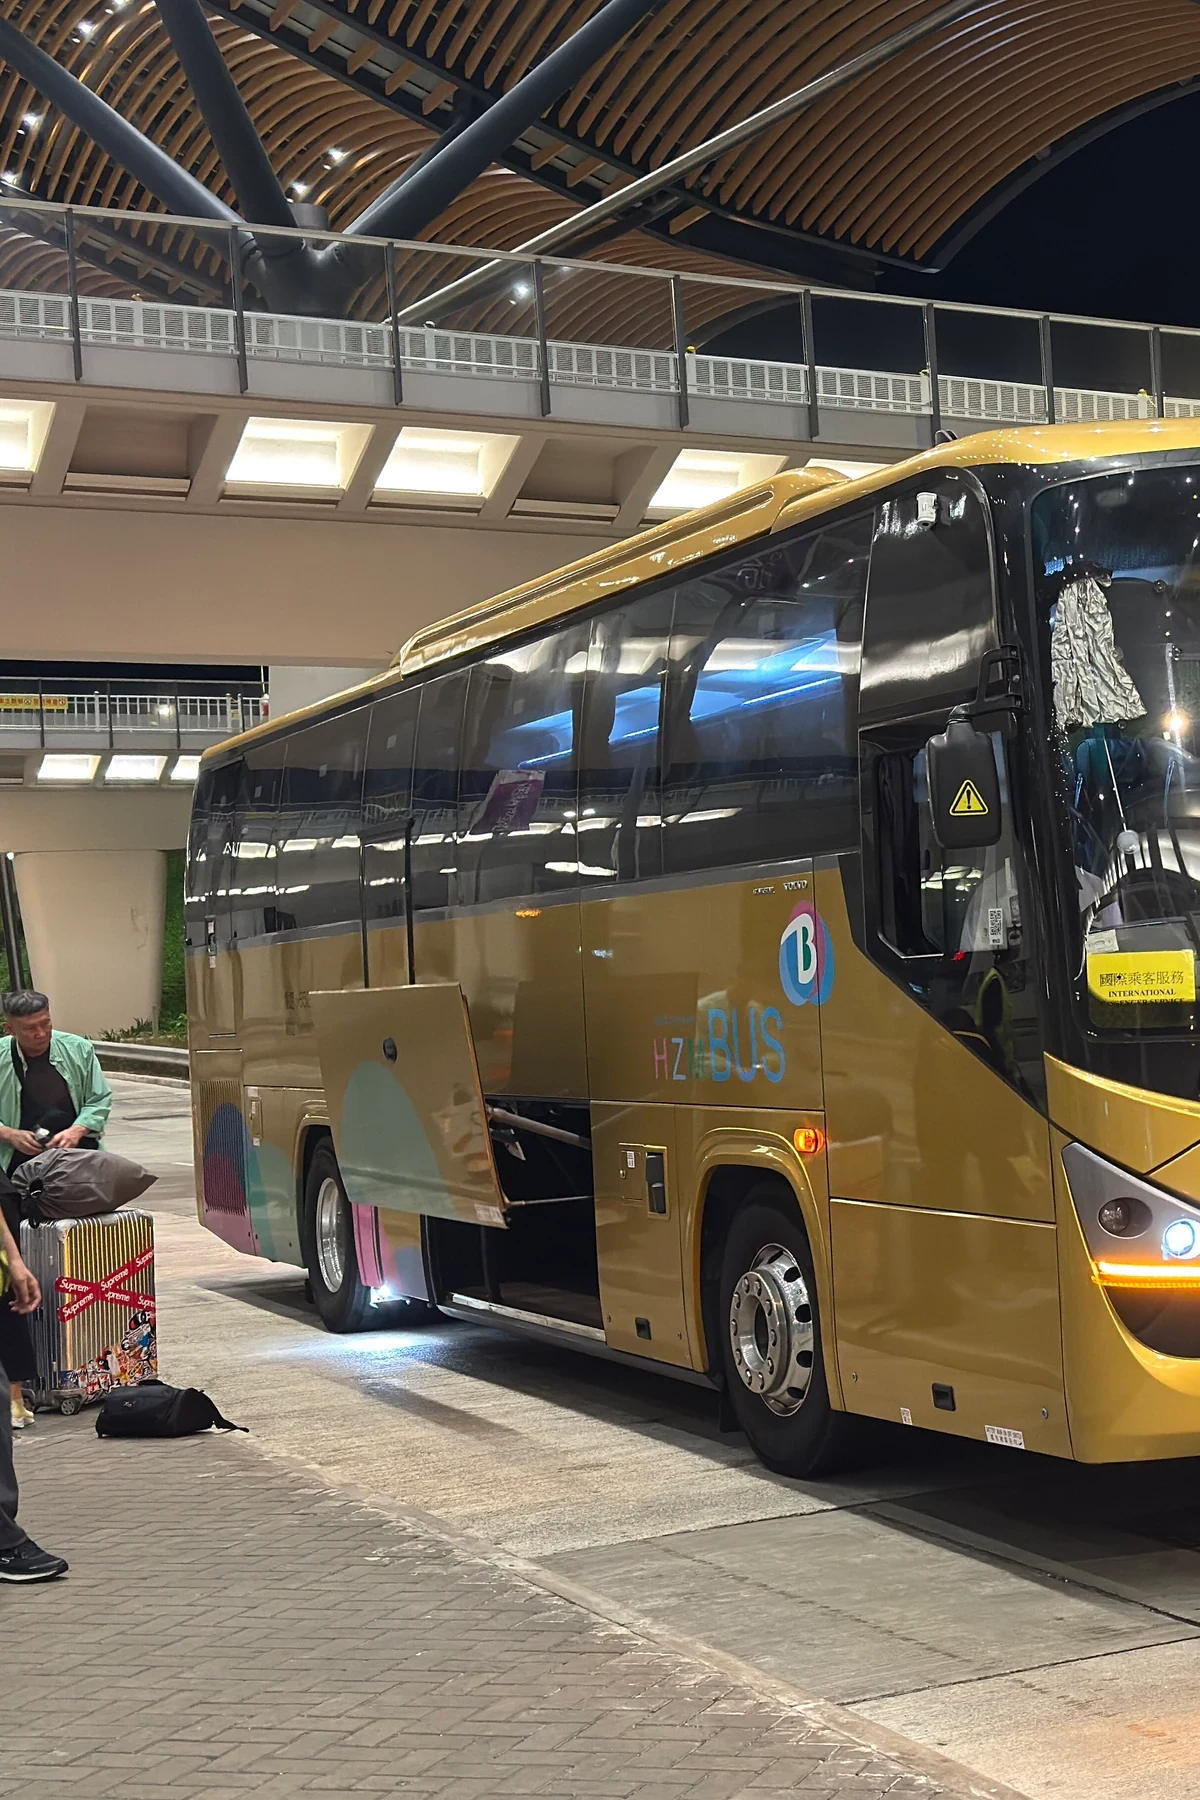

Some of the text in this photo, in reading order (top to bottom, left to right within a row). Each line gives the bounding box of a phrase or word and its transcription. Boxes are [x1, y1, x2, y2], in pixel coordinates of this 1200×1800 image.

[1108, 988, 1177, 998] INTERNATIONAL
[59, 1279, 91, 1293] Suprem
[62, 1250, 154, 1317] Supreme Supreme Supre
